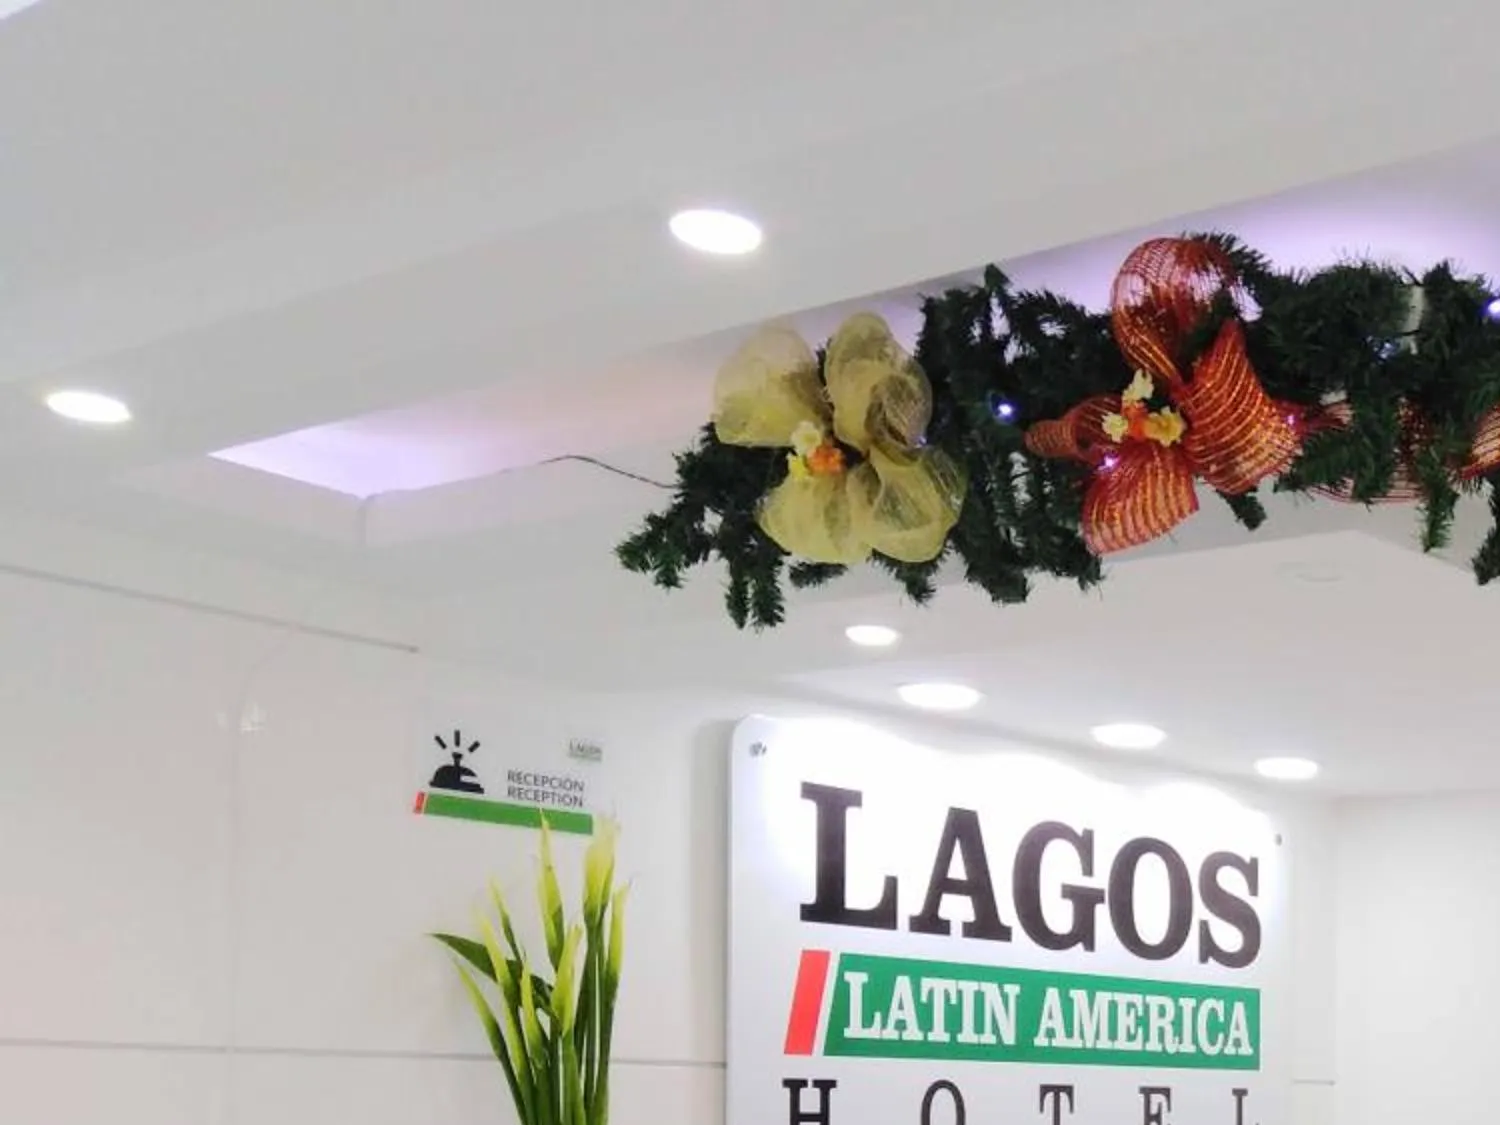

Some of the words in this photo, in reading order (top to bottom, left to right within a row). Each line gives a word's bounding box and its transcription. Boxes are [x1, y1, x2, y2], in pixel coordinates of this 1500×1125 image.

[506, 785, 584, 808] RECEPTION
[799, 781, 1263, 969] LAGOS
[842, 971, 1020, 1046] LATIN
[1033, 987, 1255, 1056] AMERICA
